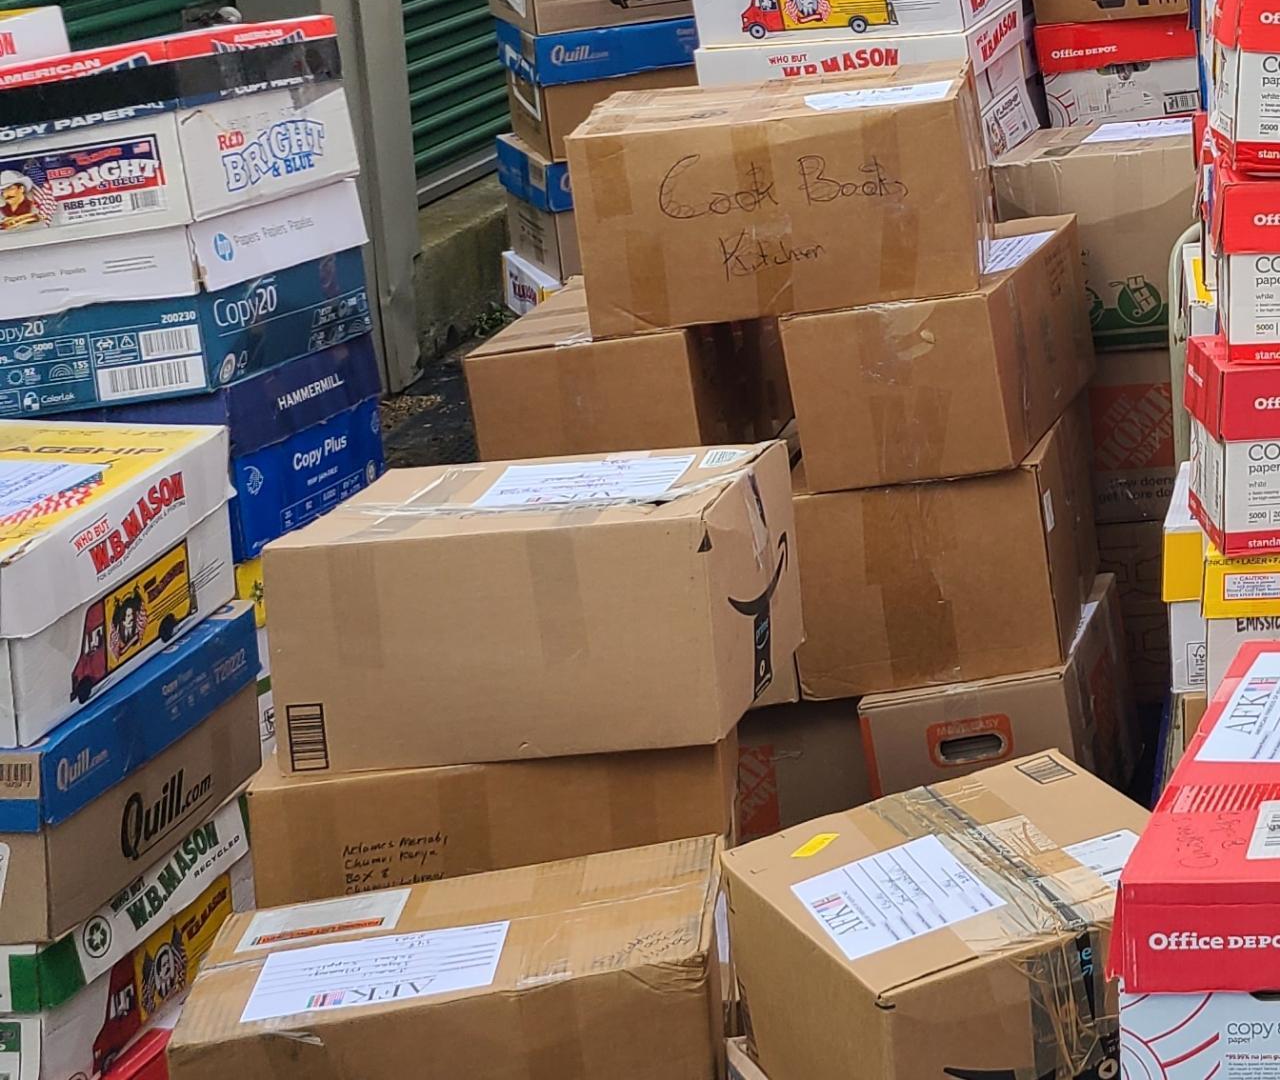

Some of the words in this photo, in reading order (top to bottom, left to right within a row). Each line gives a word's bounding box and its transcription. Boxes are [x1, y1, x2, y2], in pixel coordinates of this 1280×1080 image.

[769, 56, 788, 64] WHO
[791, 54, 807, 63] BUT
[1051, 48, 1083, 59] Office
[54, 107, 136, 131] PAPER
[1260, 123, 1279, 131] 5000
[218, 130, 244, 151] RED
[222, 118, 325, 193] BRIGHT
[283, 153, 315, 176] BLUE
[51, 159, 160, 196] BRIGHT
[160, 310, 197, 324] 200230
[214, 285, 277, 327] Copy20
[1256, 323, 1275, 331] 5000
[74, 337, 85, 347] 10
[278, 373, 345, 410] HAMMERMILL
[293, 450, 323, 471] Copy
[324, 435, 347, 458] Plus
[73, 531, 94, 551] WHO
[94, 519, 111, 538] BUT
[88, 471, 186, 575] W.B.MASON
[1223, 690, 1274, 737] AFK
[121, 768, 212, 861] Quill.com
[193, 834, 241, 878] RECYCLED
[125, 821, 220, 931] W.B.MASON
[1149, 932, 1224, 951] Office
[1227, 1020, 1274, 1039] copy
[1227, 1036, 1251, 1045] paper
